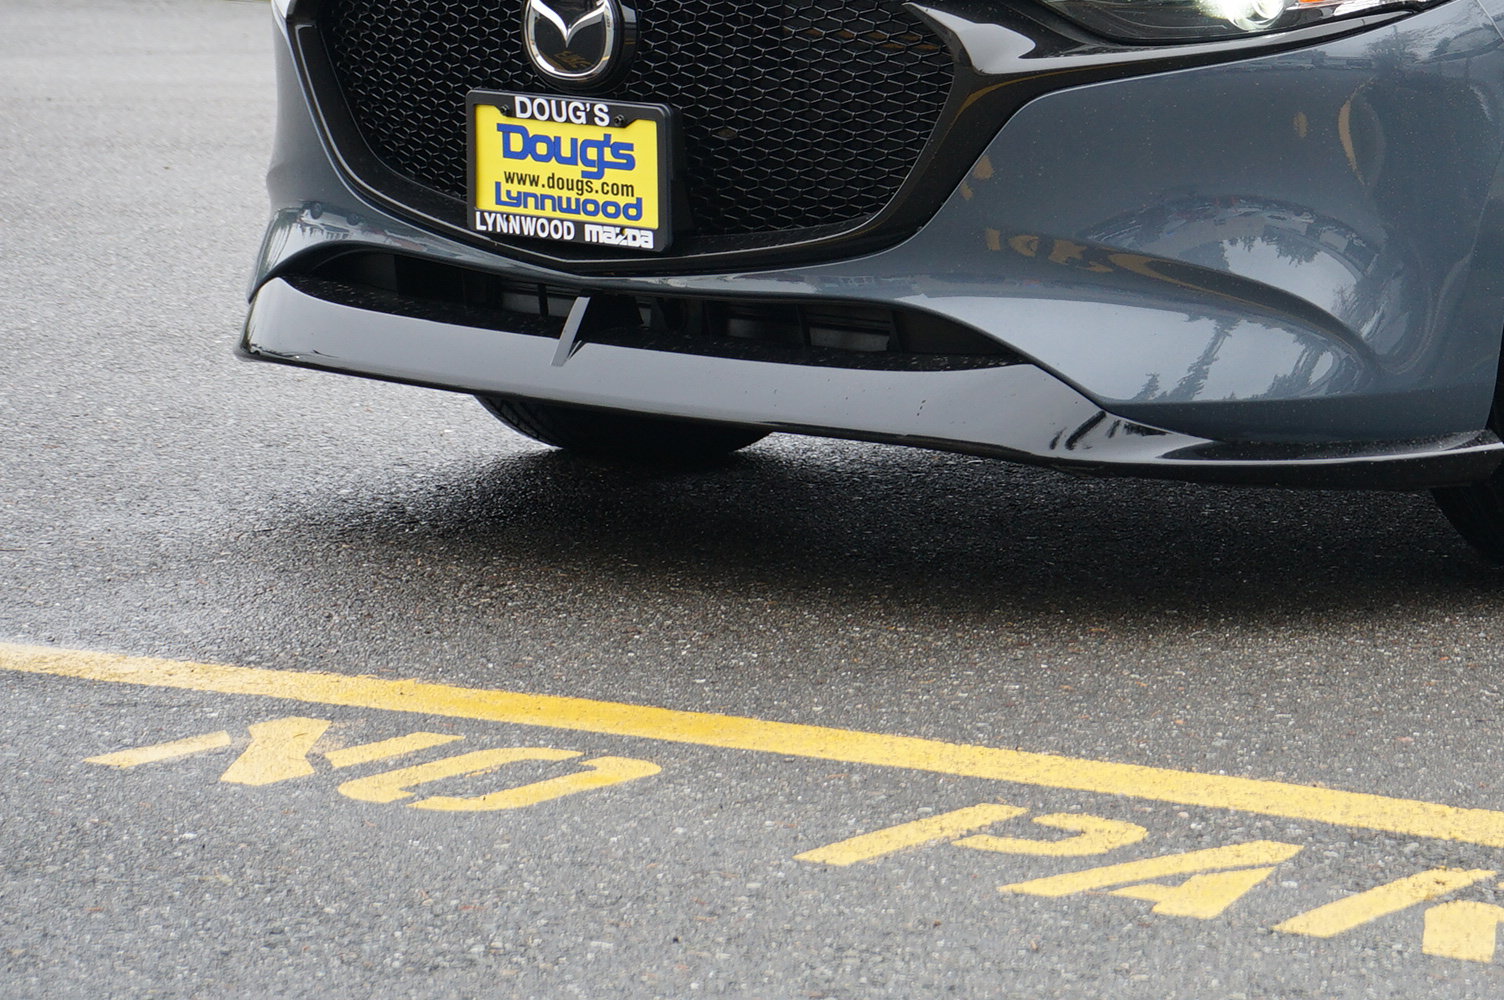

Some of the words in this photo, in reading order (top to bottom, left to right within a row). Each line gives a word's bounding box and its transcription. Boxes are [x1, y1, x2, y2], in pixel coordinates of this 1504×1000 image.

[514, 95, 610, 127] DOUG'S
[496, 122, 636, 180] Doug's
[495, 181, 643, 221] Lynnwood
[503, 170, 635, 198] www.dougs.com
[475, 211, 575, 241] LYNNWOOD
[584, 223, 655, 250] mazda
[83, 716, 662, 812] NO
